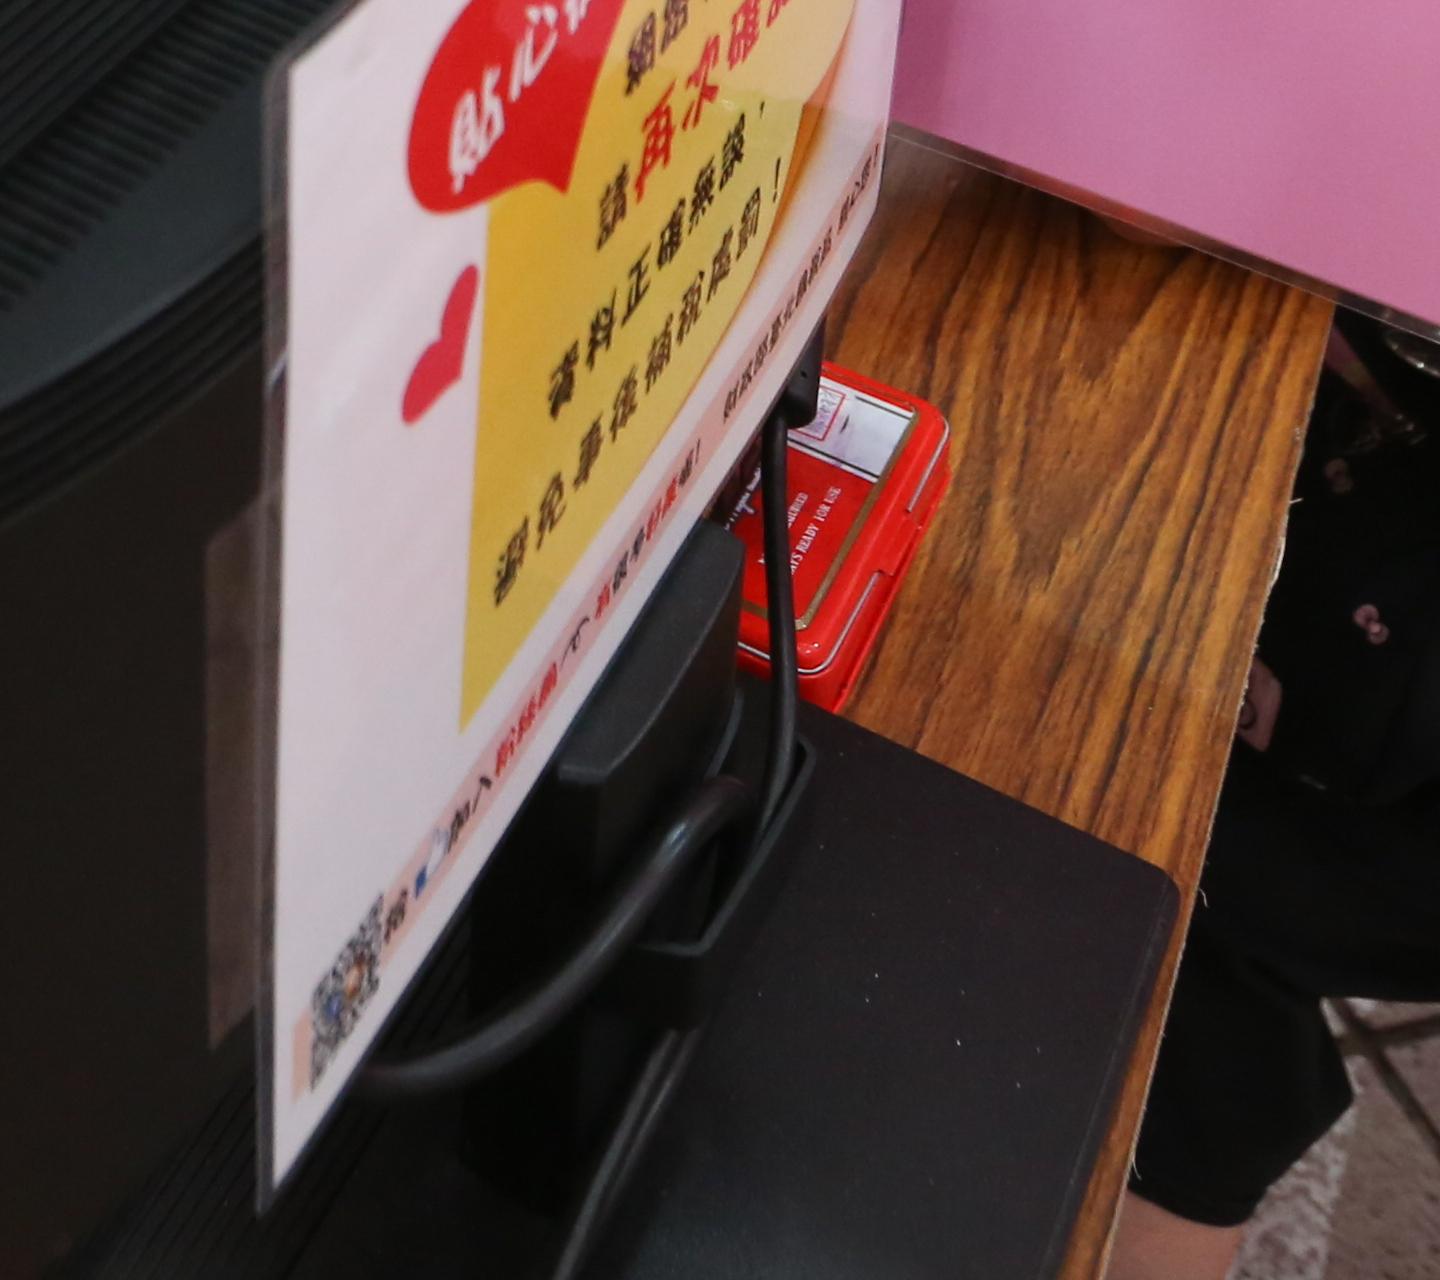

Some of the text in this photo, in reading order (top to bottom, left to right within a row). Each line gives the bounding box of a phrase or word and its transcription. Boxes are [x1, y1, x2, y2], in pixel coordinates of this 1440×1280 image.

[796, 523, 819, 553] READY
[814, 504, 831, 521] FOR
[824, 486, 842, 503] USE
